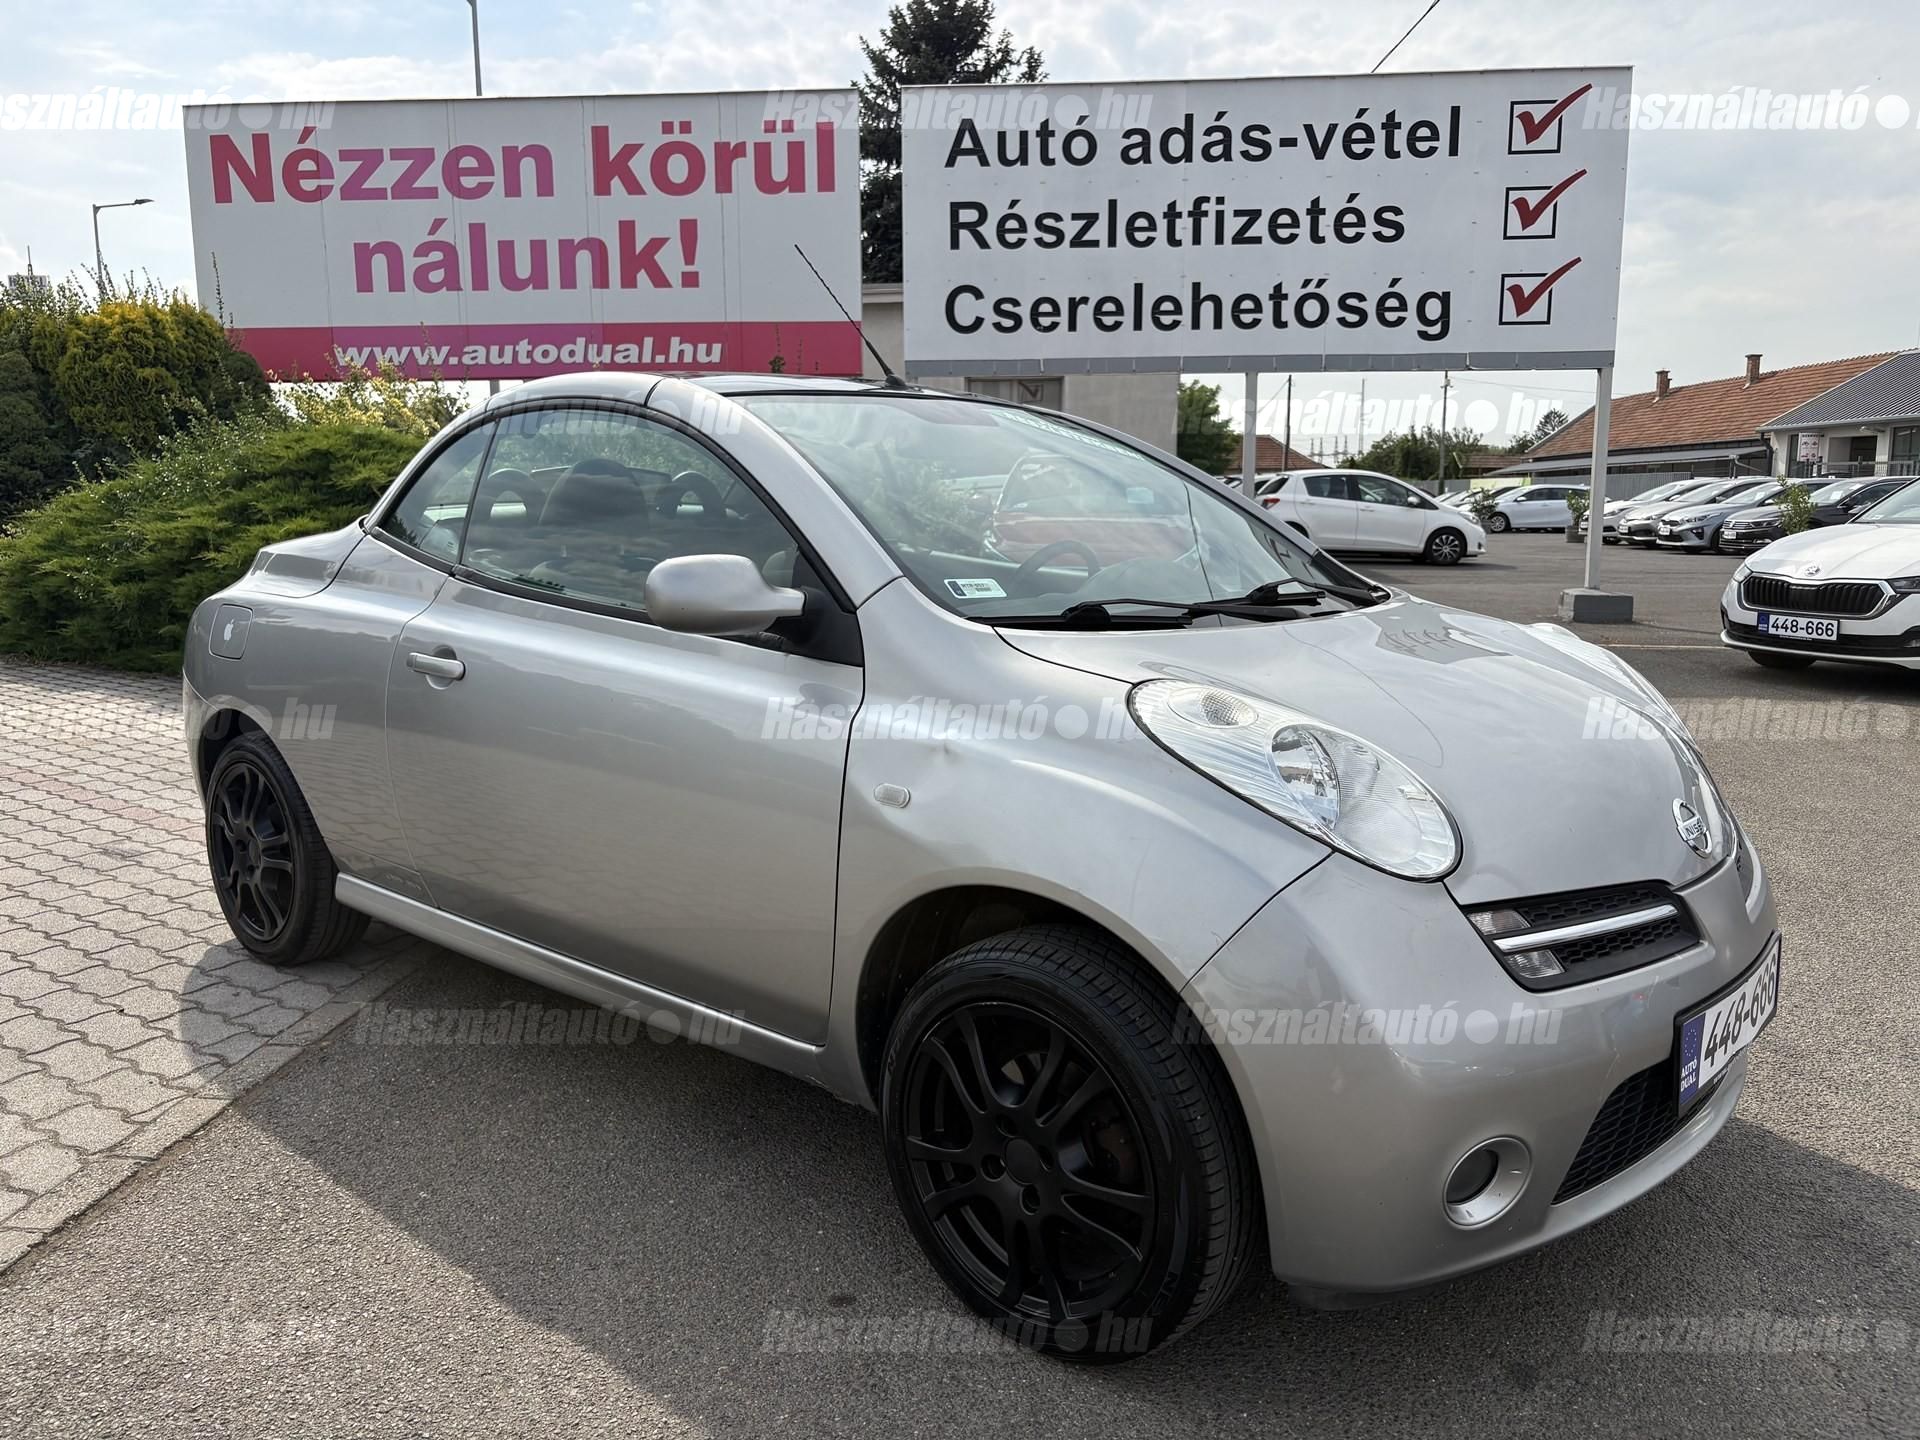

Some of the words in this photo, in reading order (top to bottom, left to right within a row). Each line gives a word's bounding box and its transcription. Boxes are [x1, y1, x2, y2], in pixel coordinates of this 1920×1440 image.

[210, 126, 555, 204] Nézzen
[590, 119, 836, 198] körül
[944, 114, 1098, 168] Autó
[1120, 105, 1461, 165] adás-vétel
[949, 193, 1405, 250] Részletfizetés
[353, 218, 700, 294] nálunk!
[944, 278, 1452, 342] Cserelehetőség
[333, 336, 722, 367] www.autodual.hu
[1771, 617, 1835, 637] 448-666
[1704, 953, 1777, 1068] 448-666
[1681, 1071, 1696, 1092] DUAL
